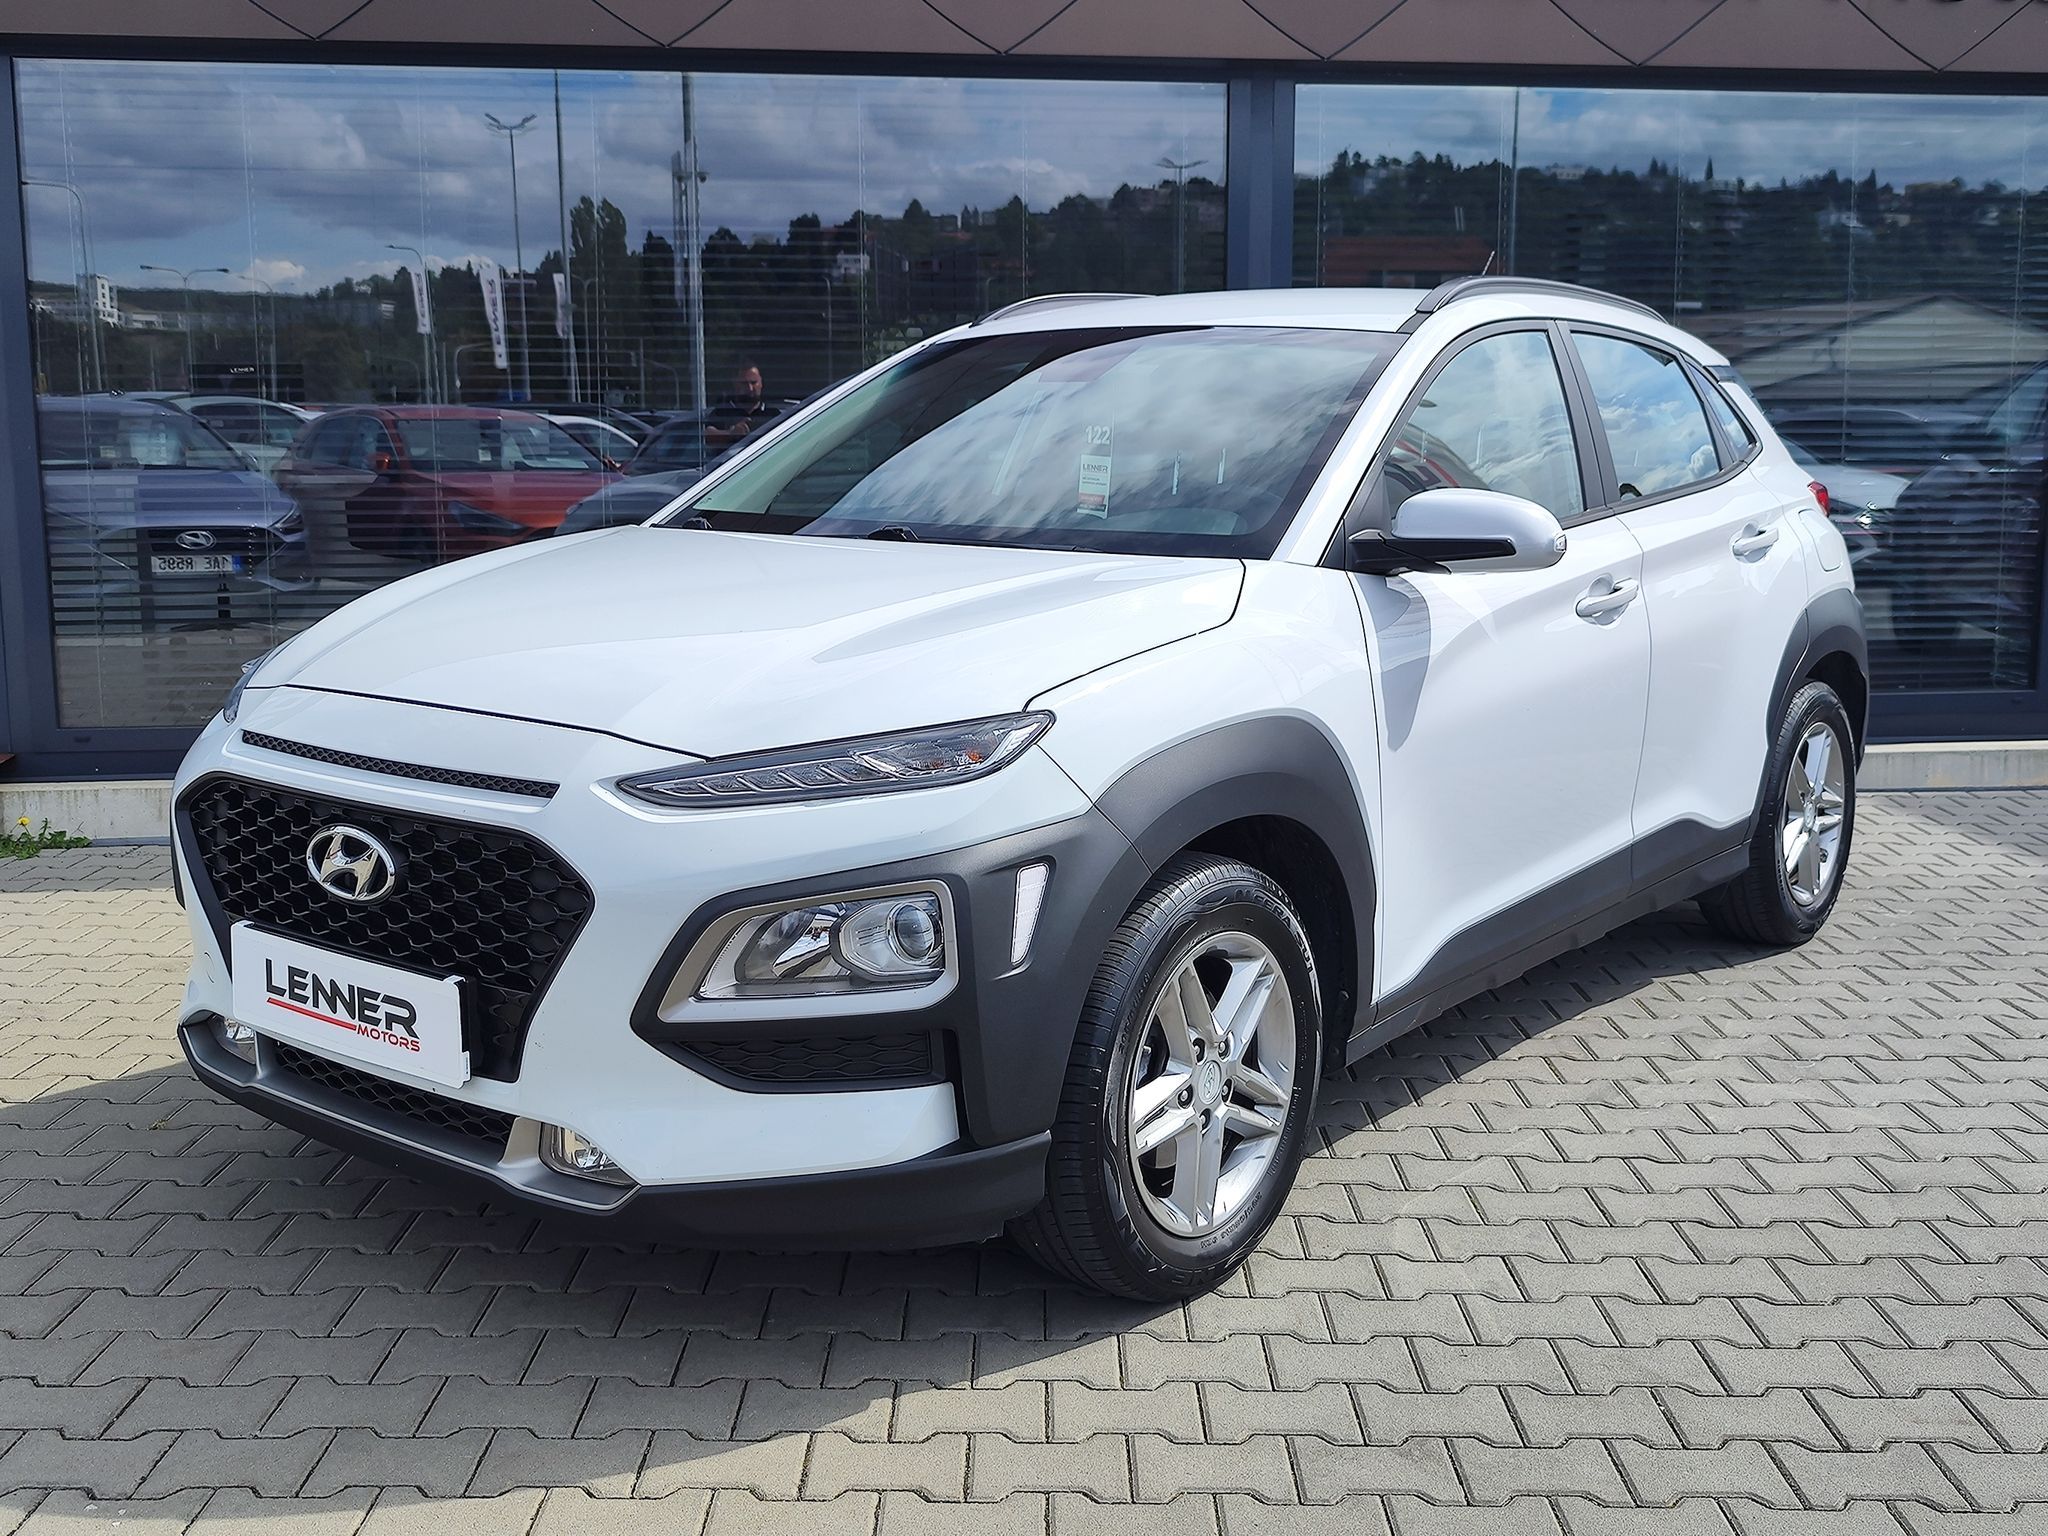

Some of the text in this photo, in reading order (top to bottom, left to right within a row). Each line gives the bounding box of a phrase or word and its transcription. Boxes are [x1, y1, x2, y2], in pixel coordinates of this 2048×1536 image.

[1085, 425, 1111, 445] 122
[1082, 463, 1109, 474] LENNER
[265, 957, 420, 1041] LENNER
[356, 1023, 421, 1053] MOTORS
